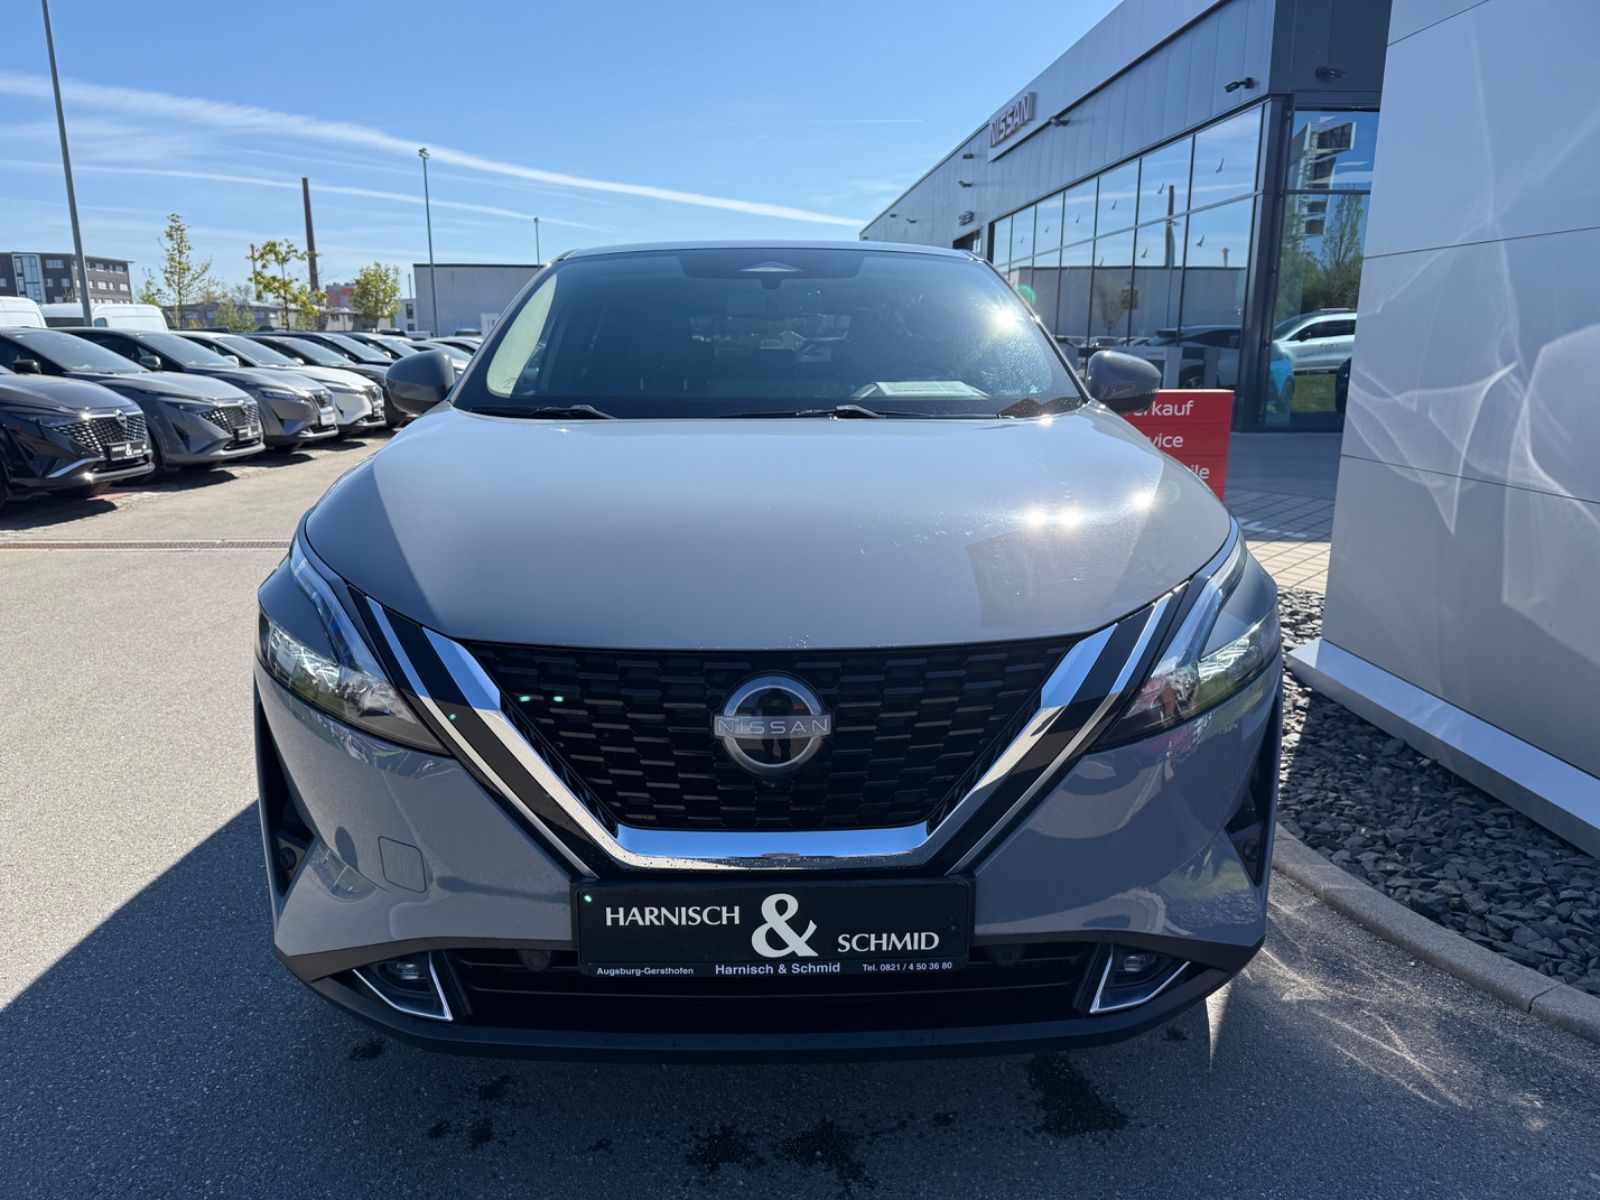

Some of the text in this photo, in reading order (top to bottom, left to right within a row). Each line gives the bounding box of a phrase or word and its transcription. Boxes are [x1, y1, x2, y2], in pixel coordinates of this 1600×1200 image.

[990, 92, 1035, 148] NISSAN
[1131, 400, 1194, 417] kauf
[717, 718, 829, 735] NISSAN
[605, 893, 940, 958] HARNISCH & SCHMID
[596, 966, 694, 977] Augsburg-Gersthofen
[715, 962, 841, 975] Harnisch & Schmid
[862, 963, 878, 972] Tel.
[880, 963, 900, 972] 0821
[908, 963, 915, 971] 4
[916, 962, 927, 971] 50
